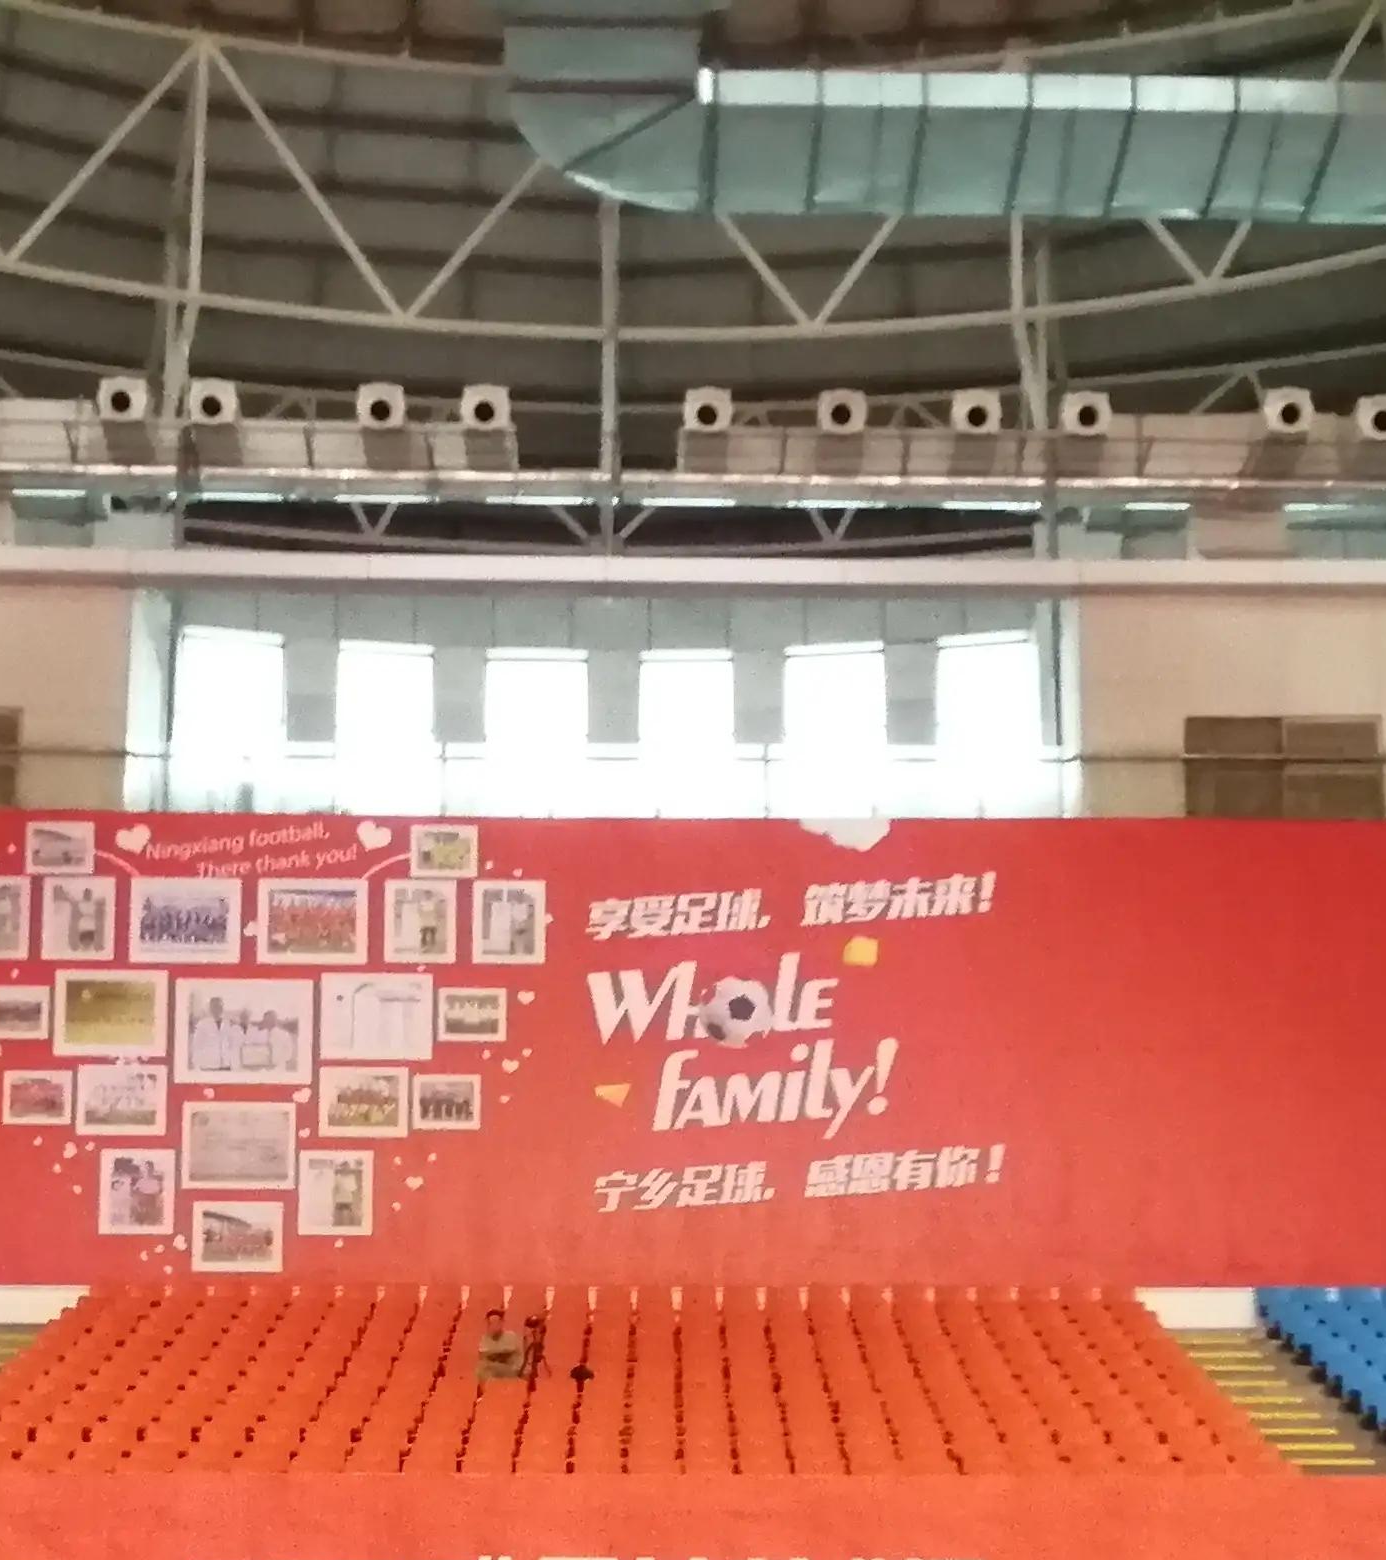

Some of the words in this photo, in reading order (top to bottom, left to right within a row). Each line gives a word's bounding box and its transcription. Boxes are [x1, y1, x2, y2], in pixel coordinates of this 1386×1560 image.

[144, 834, 244, 861] Ningxiang
[255, 848, 311, 873] thank
[315, 843, 358, 870] you!
